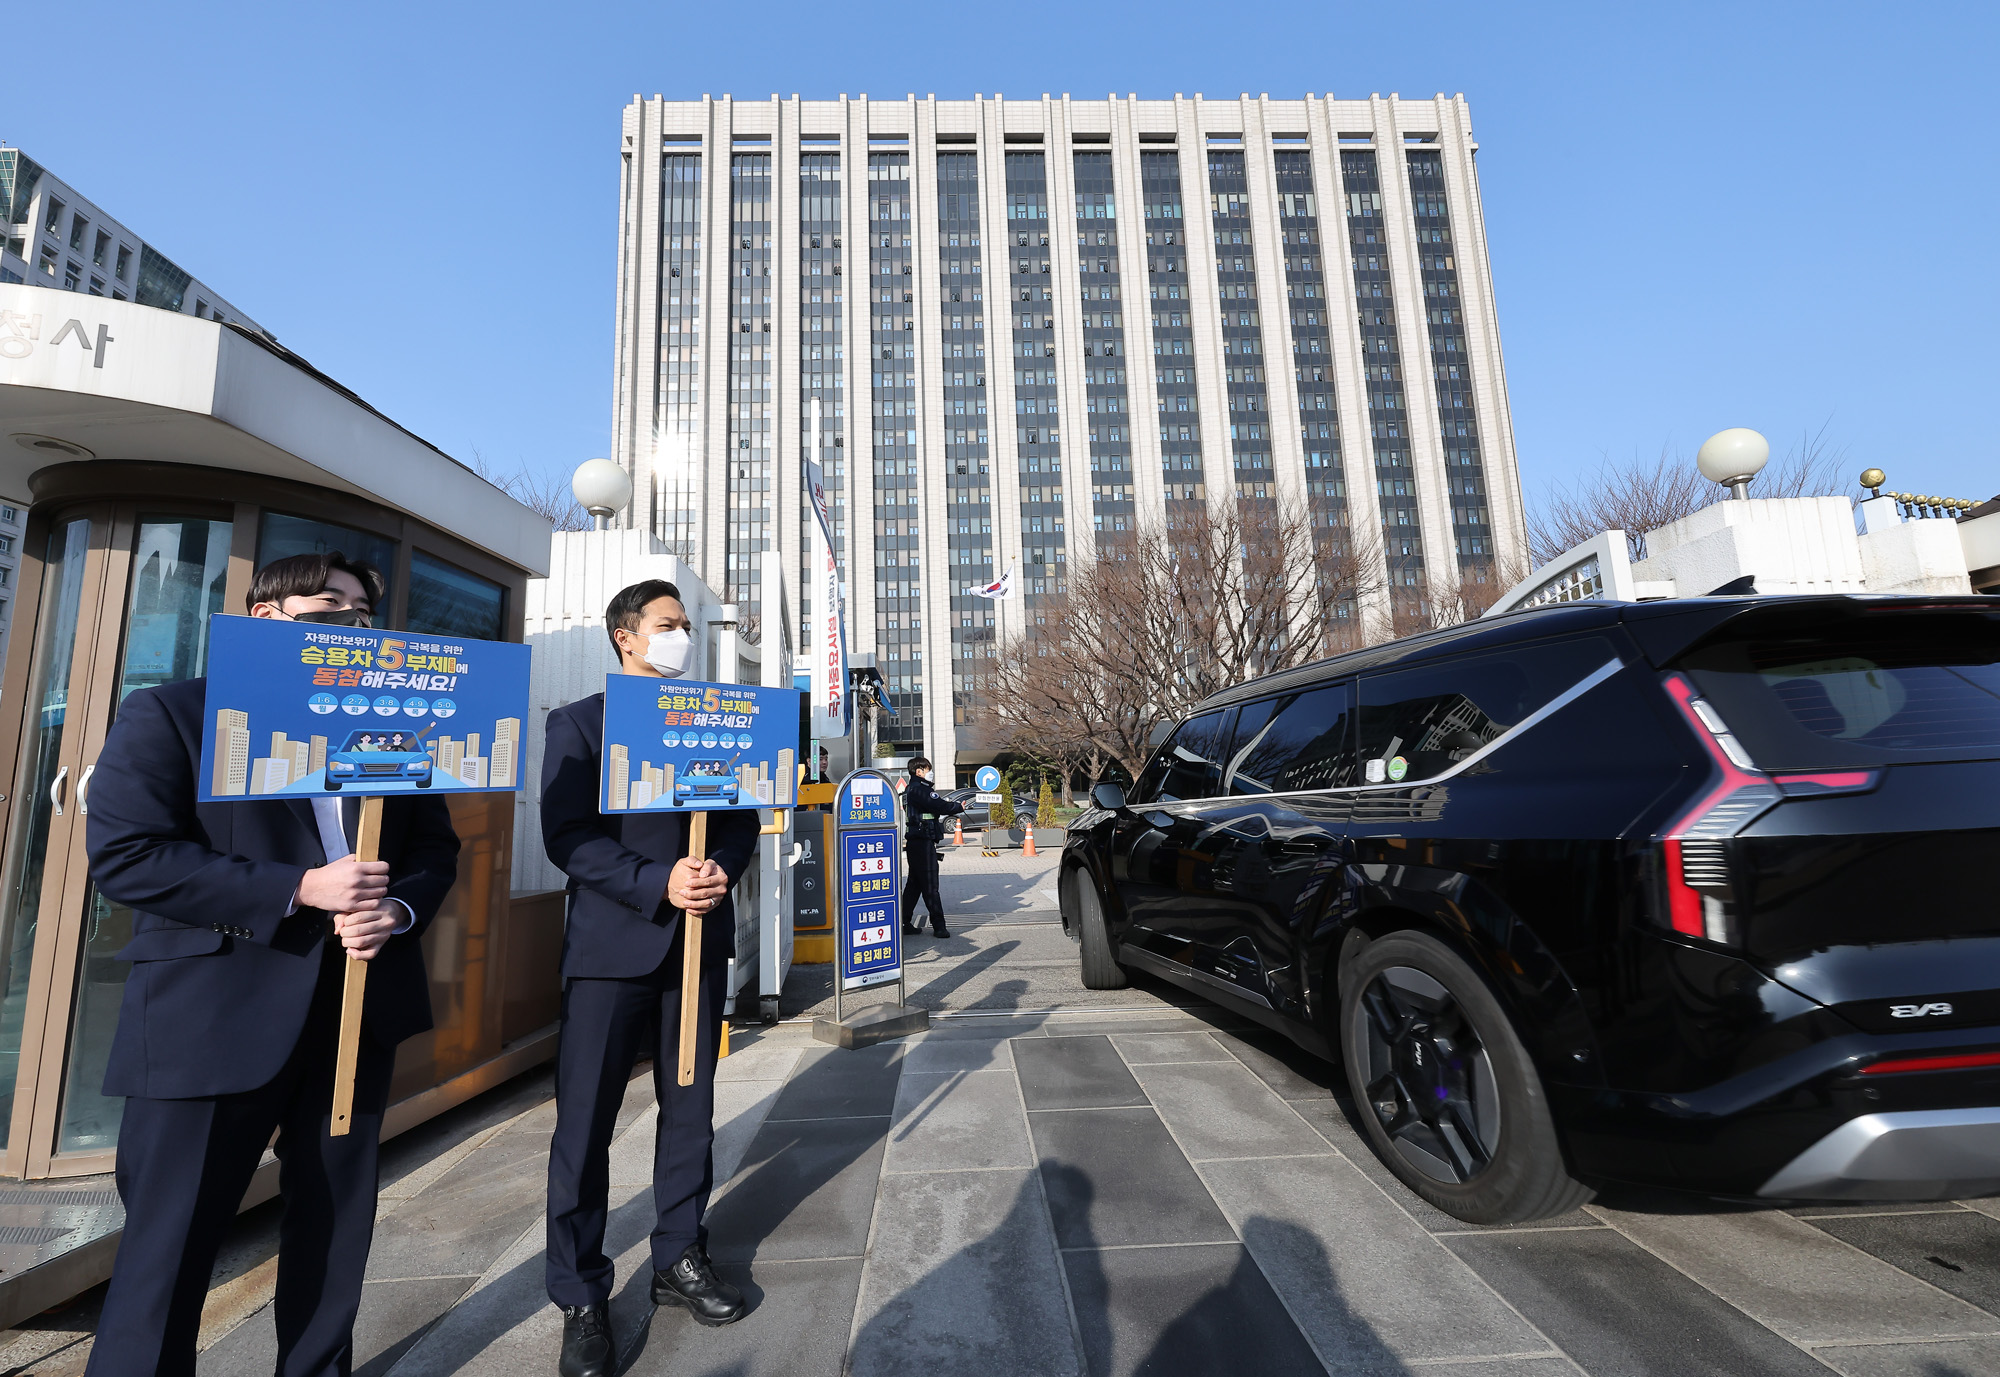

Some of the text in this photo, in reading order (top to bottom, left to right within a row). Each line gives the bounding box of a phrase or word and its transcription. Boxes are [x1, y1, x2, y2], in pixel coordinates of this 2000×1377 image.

[305, 632, 463, 655] 자원안보위기 극복을 위한
[301, 646, 374, 668] 승용차
[828, 616, 841, 718] 국가중요시설
[312, 667, 457, 692] 동참해주세요!
[660, 684, 703, 696] 자원안보위기
[658, 695, 701, 711] 승용차
[665, 711, 752, 728] 동참해주세요!
[855, 796, 880, 807] 5 부제
[849, 809, 887, 820] 요일제 적용
[858, 842, 883, 854] 오늘은
[877, 860, 883, 870] 8
[852, 878, 890, 893] 출입제한
[859, 909, 885, 923] 내일은
[878, 928, 884, 939] 9
[854, 946, 892, 964] 출입제한
[1890, 1003, 1952, 1018] EV9
